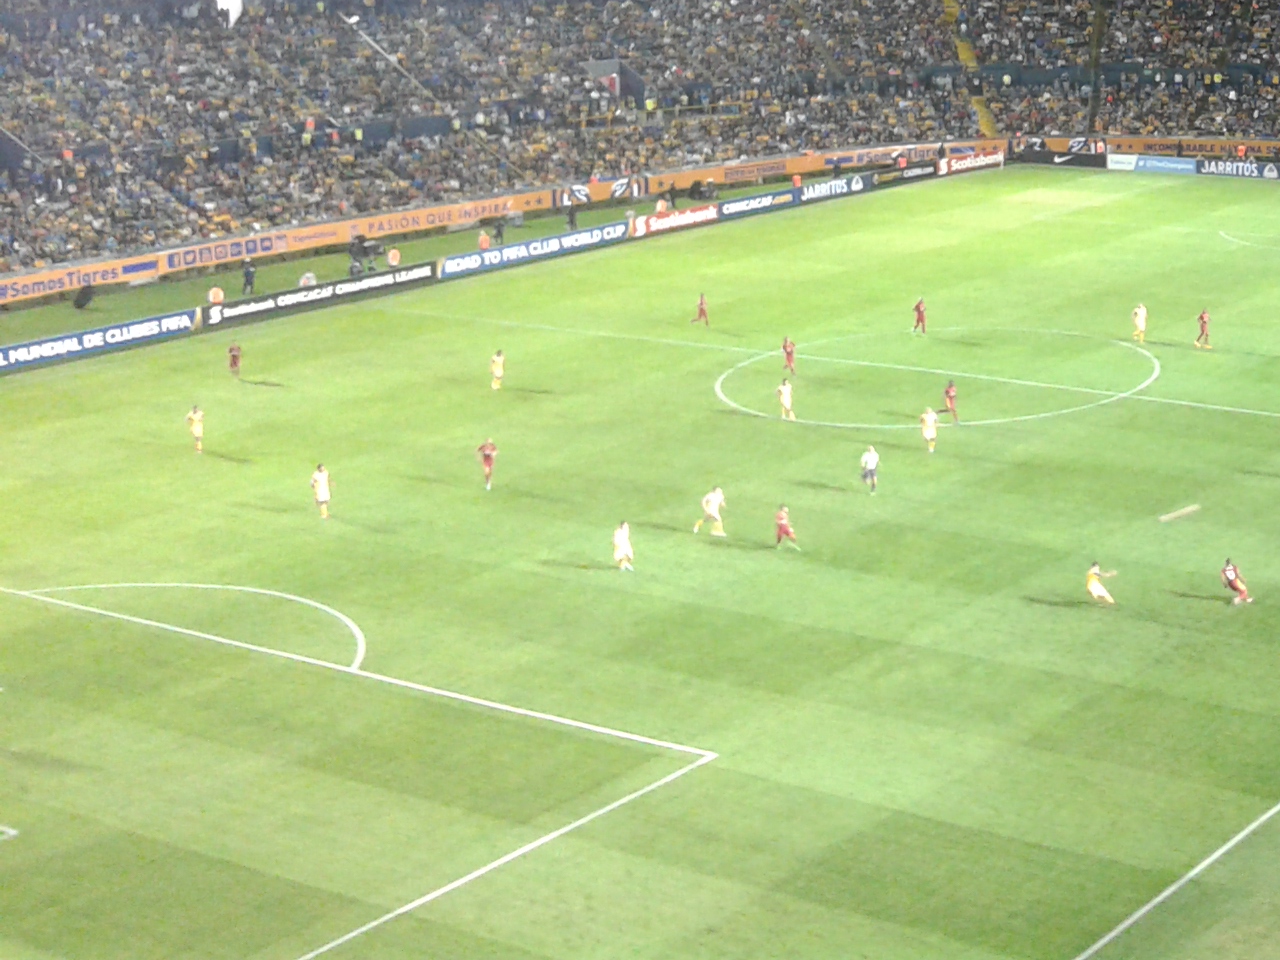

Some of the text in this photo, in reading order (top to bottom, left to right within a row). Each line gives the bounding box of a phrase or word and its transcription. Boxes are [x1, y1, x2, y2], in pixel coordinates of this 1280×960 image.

[951, 151, 1004, 170] Scotiabank
[1201, 160, 1258, 177] JARRITOS
[801, 178, 848, 201] JARRITOS
[368, 202, 511, 233] PASIÓN QUE INSPIRA
[650, 204, 718, 231] Scotiabank
[445, 224, 626, 273] ROAD TO FIFA CLUB WORLD CUP
[9, 338, 82, 363] MUNDIAL
[83, 332, 104, 348] DE
[105, 320, 160, 343] CLUBES
[161, 314, 192, 332] FIFA
